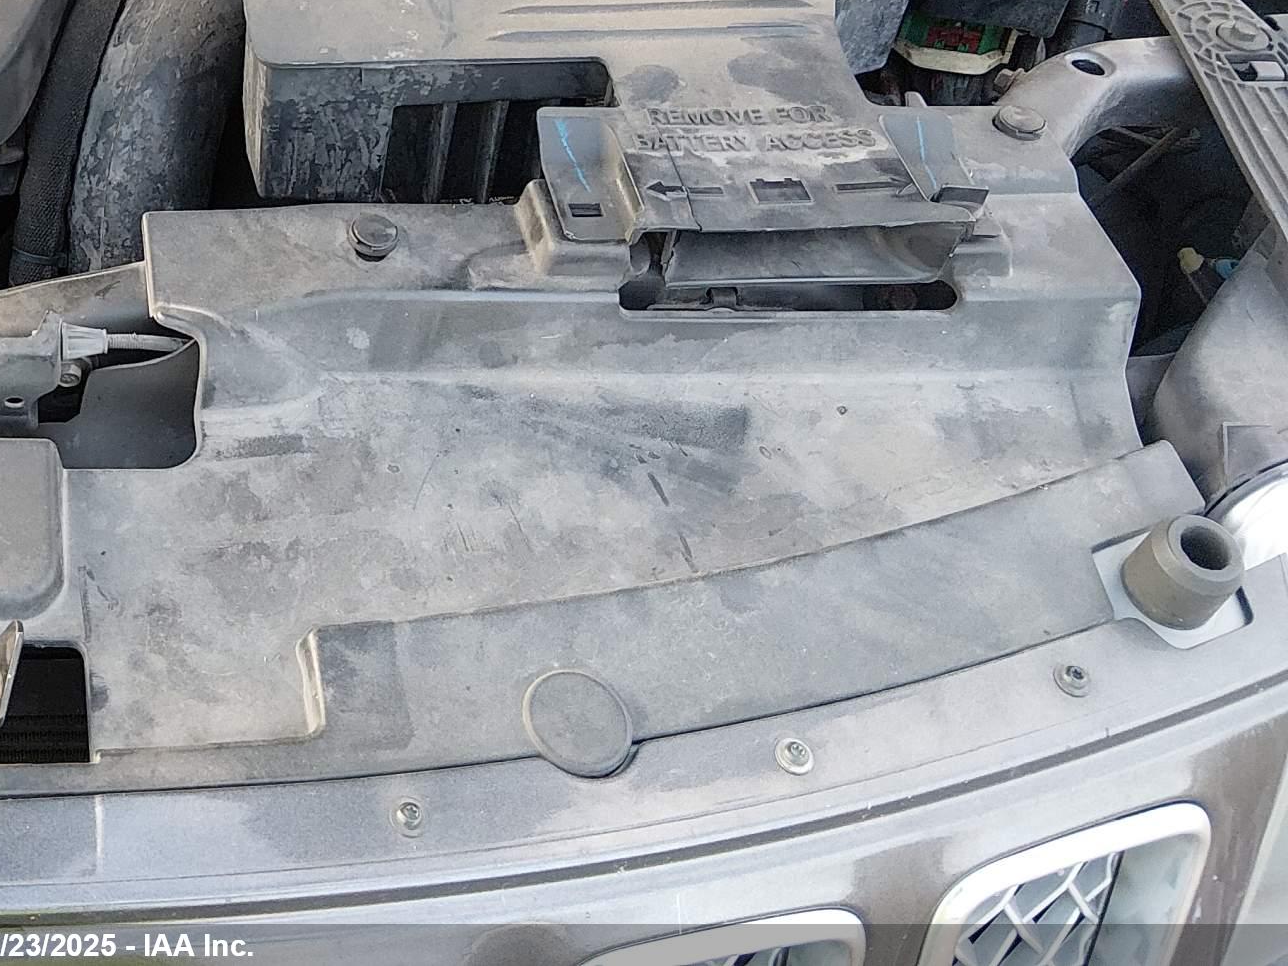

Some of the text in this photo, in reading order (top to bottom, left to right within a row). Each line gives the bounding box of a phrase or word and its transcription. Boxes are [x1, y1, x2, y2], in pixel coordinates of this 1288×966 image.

[646, 105, 833, 127] REMOVE FOR
[633, 129, 878, 153] BATTERY ACCESS
